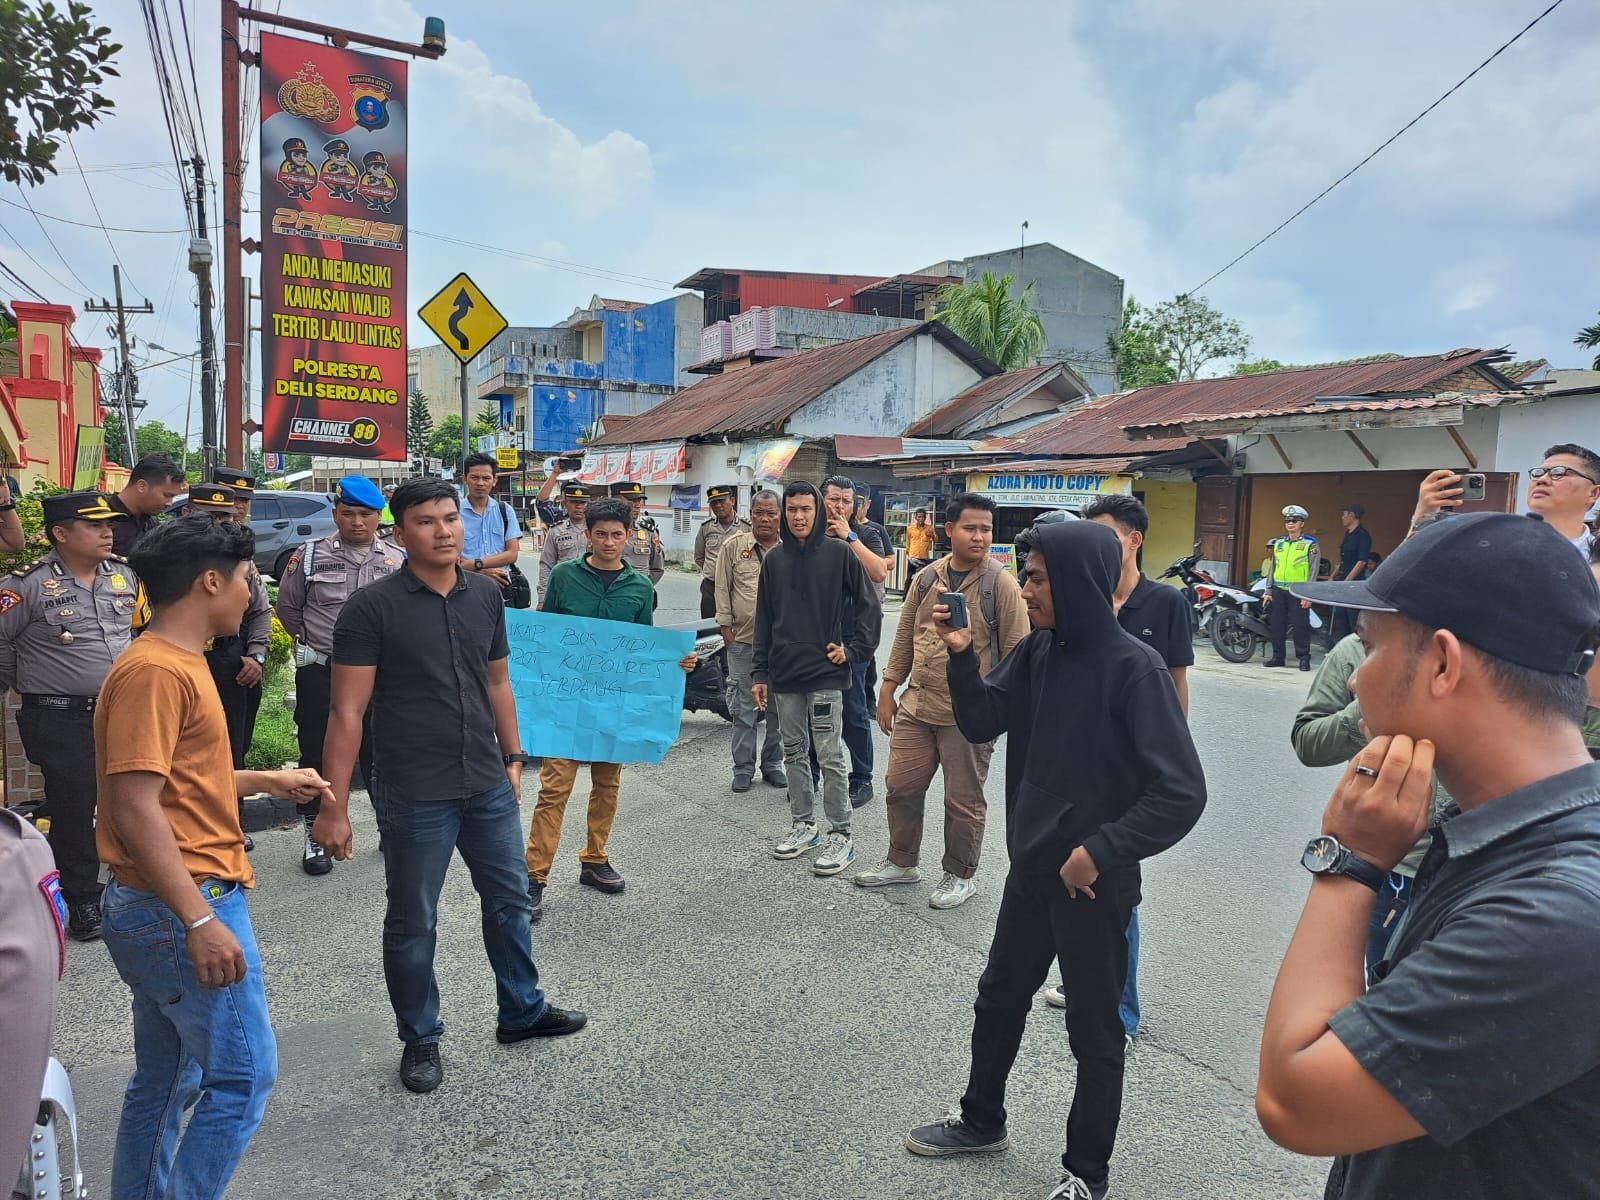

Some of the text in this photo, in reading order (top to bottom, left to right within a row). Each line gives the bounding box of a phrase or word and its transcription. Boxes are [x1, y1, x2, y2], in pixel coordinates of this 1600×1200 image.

[272, 208, 404, 243] PRESISI
[282, 253, 392, 289] ANDA MEMASUKI
[284, 284, 391, 318] KAWASAN WAJIB
[272, 313, 401, 349] TERTIB LALU LINTAS
[293, 358, 382, 382] POLRESTA
[275, 379, 399, 405] DELI SERDANG
[293, 420, 376, 440] CHANNEL 88
[987, 475, 1021, 490] AZURA
[1024, 474, 1064, 490] PHOTO
[560, 627, 597, 647] BOS
[610, 634, 656, 652] JUDI
